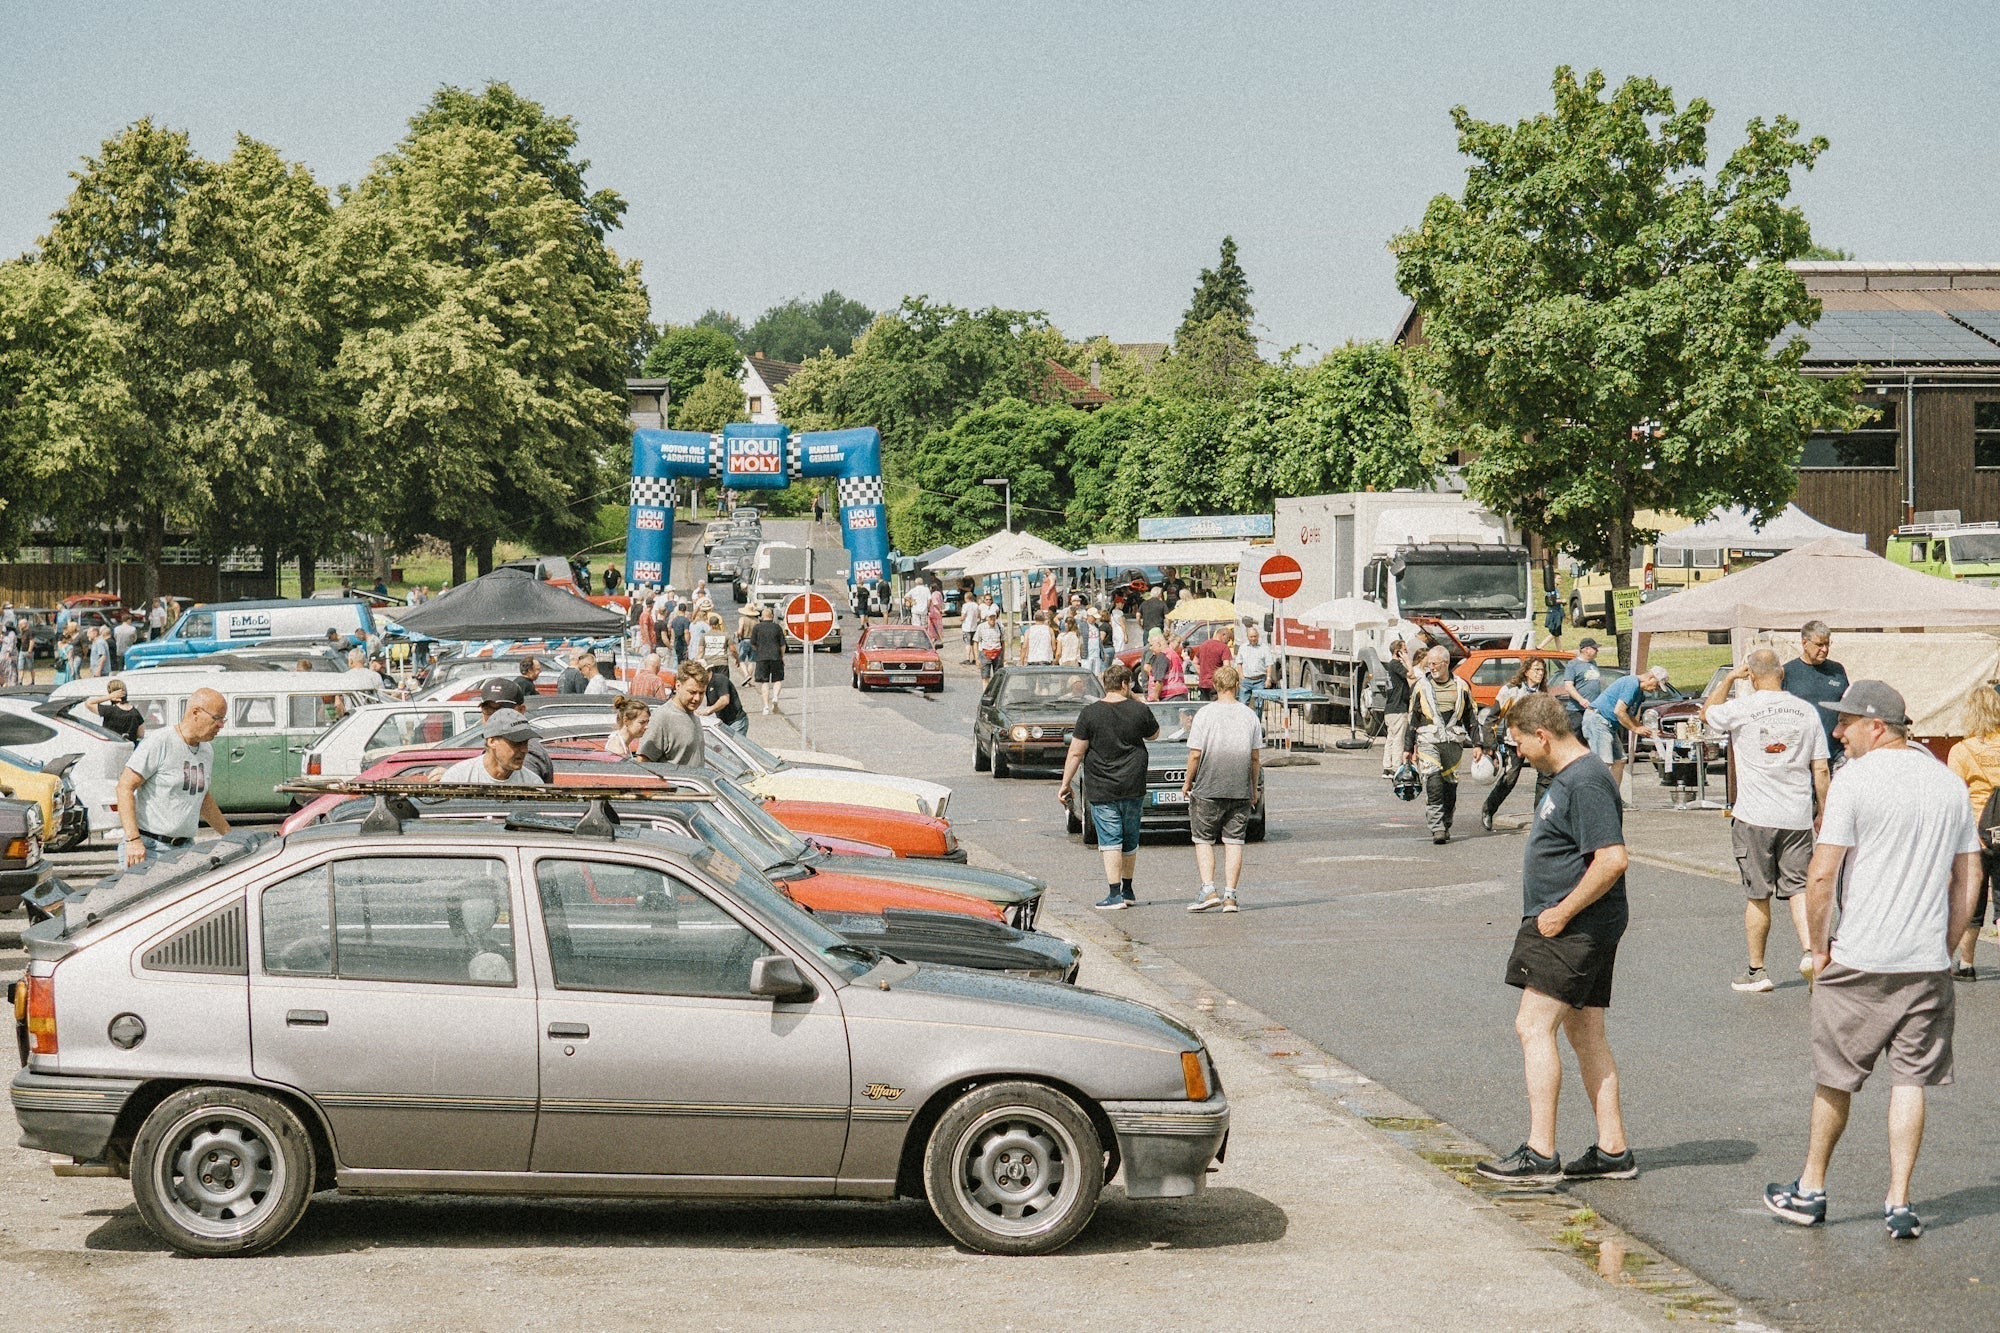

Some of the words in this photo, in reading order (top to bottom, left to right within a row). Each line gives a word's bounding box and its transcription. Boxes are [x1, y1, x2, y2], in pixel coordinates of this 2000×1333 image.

[661, 444, 688, 454] MOTOR
[730, 439, 778, 455] LIQUI
[809, 452, 844, 463] GERMANY
[730, 456, 779, 472] MOLY
[637, 509, 664, 520] LIQUI
[849, 509, 875, 519] LIQUI
[637, 519, 663, 529] MOLY
[849, 518, 876, 529] MOLY
[635, 562, 661, 572] LIQUI
[855, 560, 881, 571] LIQUI
[634, 571, 660, 581] MOLY
[1619, 600, 1634, 608] HIER
[231, 615, 269, 626] FoMoCo
[1768, 706, 1805, 718] Freunde
[1158, 792, 1177, 802] ERB
[861, 1083, 905, 1101] Tiffany
